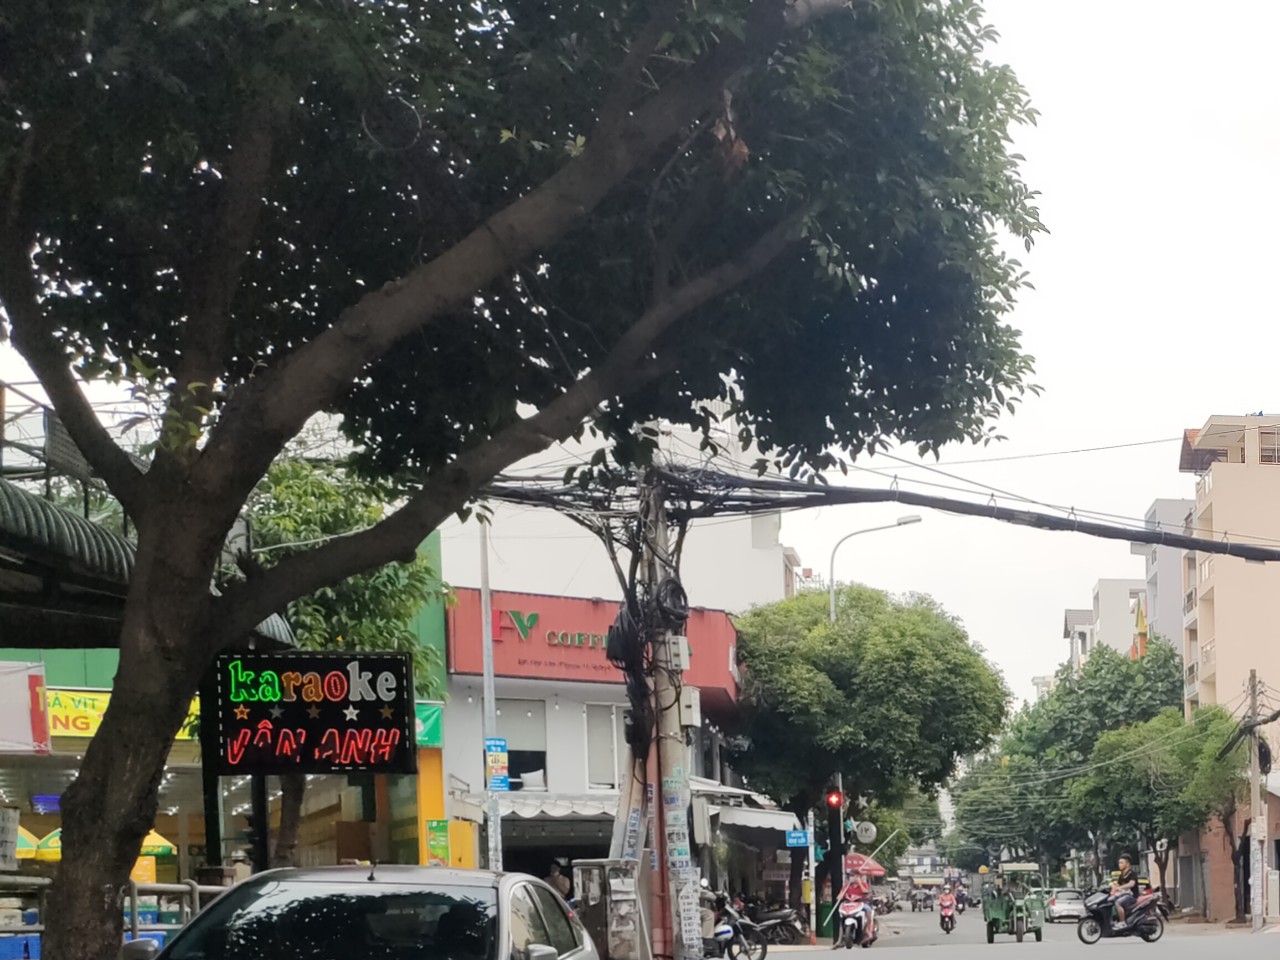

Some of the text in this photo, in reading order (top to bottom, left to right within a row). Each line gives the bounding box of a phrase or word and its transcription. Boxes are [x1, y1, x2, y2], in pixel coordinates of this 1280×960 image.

[546, 630, 608, 649] COFF
[228, 660, 397, 702] karaoke
[70, 697, 99, 713] VỊT
[227, 719, 401, 764] VÂN ANH
